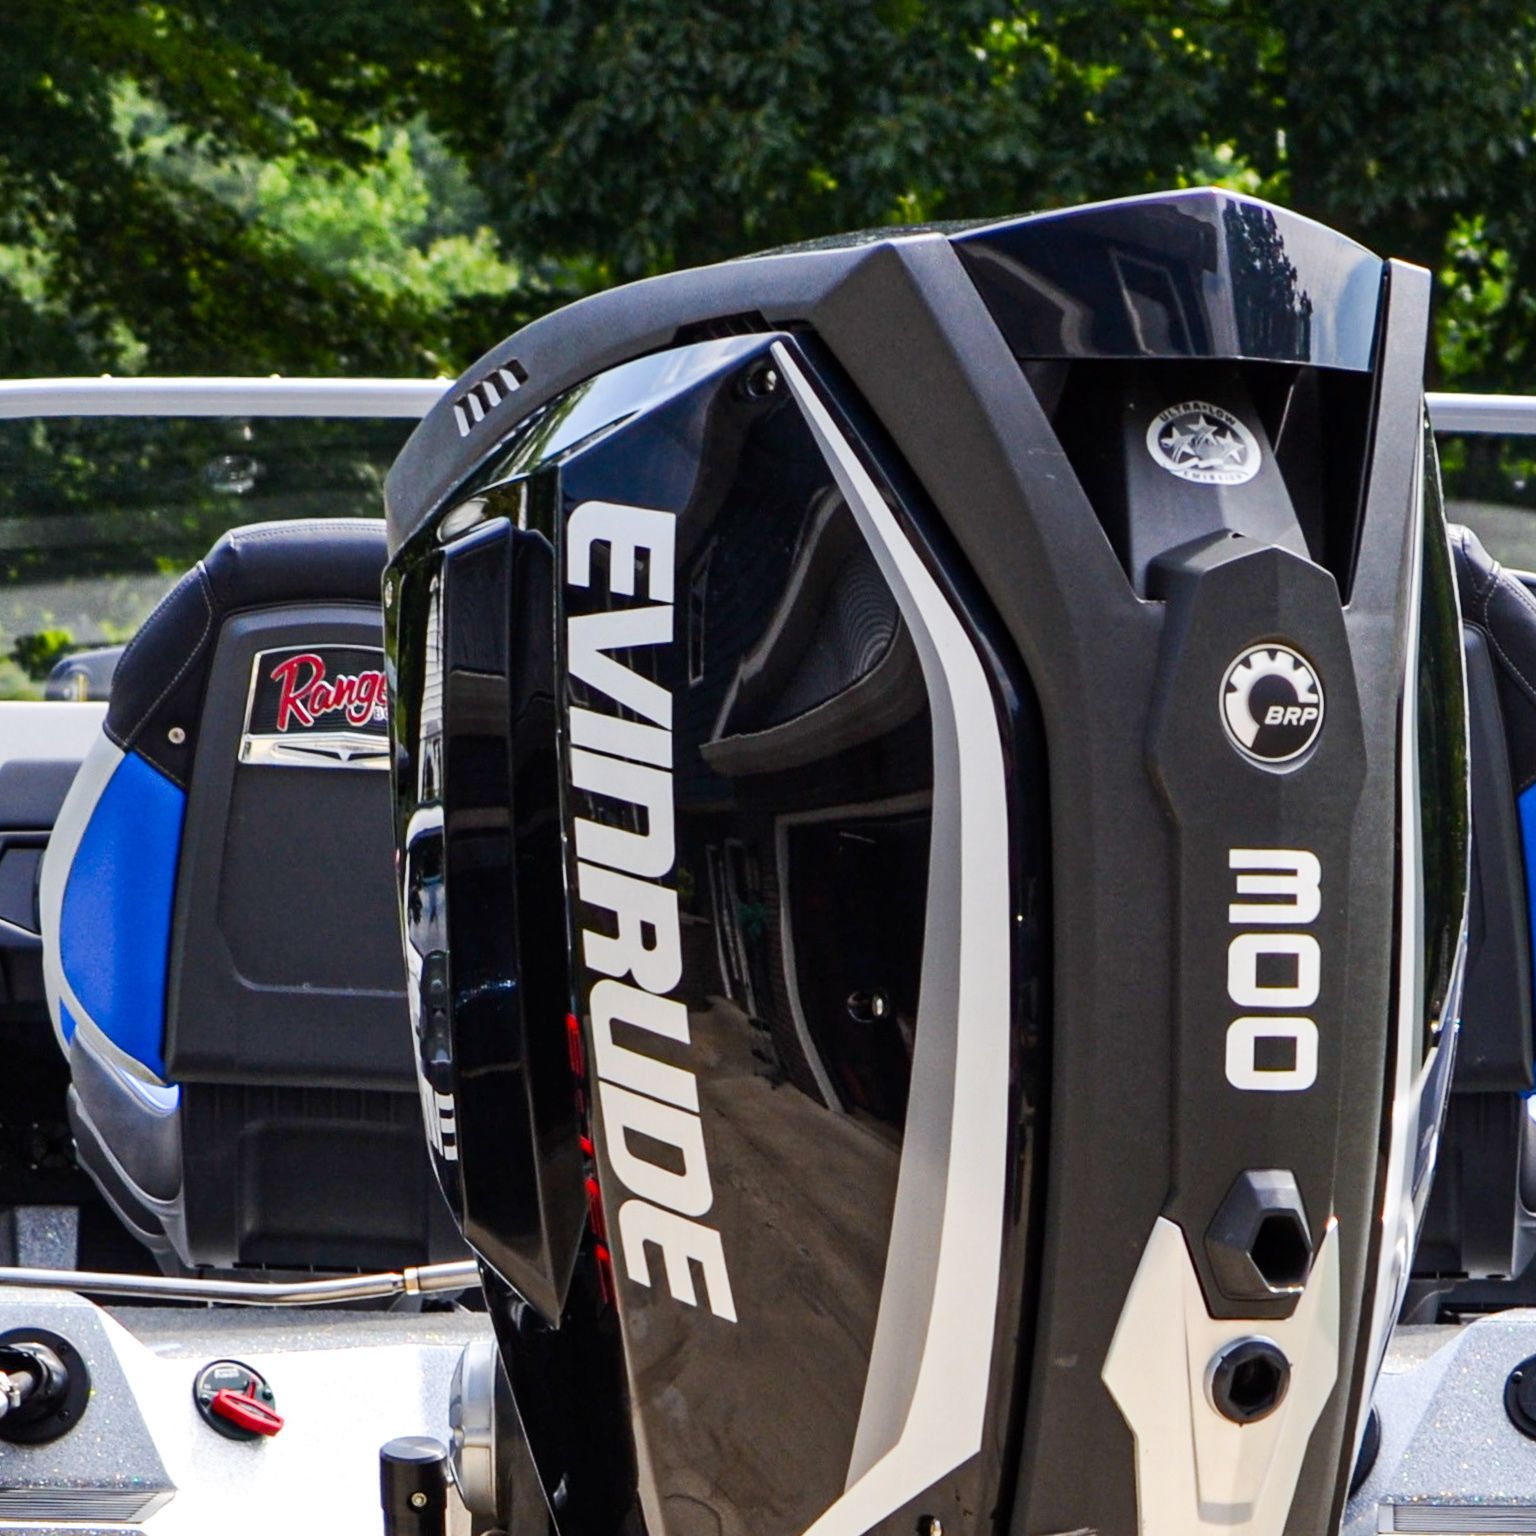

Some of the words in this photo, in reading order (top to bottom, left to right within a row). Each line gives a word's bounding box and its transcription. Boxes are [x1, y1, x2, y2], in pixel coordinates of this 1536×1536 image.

[270, 653, 387, 732] Range
[1263, 705, 1319, 726] BRP
[567, 501, 738, 1322] EVINRUDE
[1224, 848, 1322, 1092] 300
